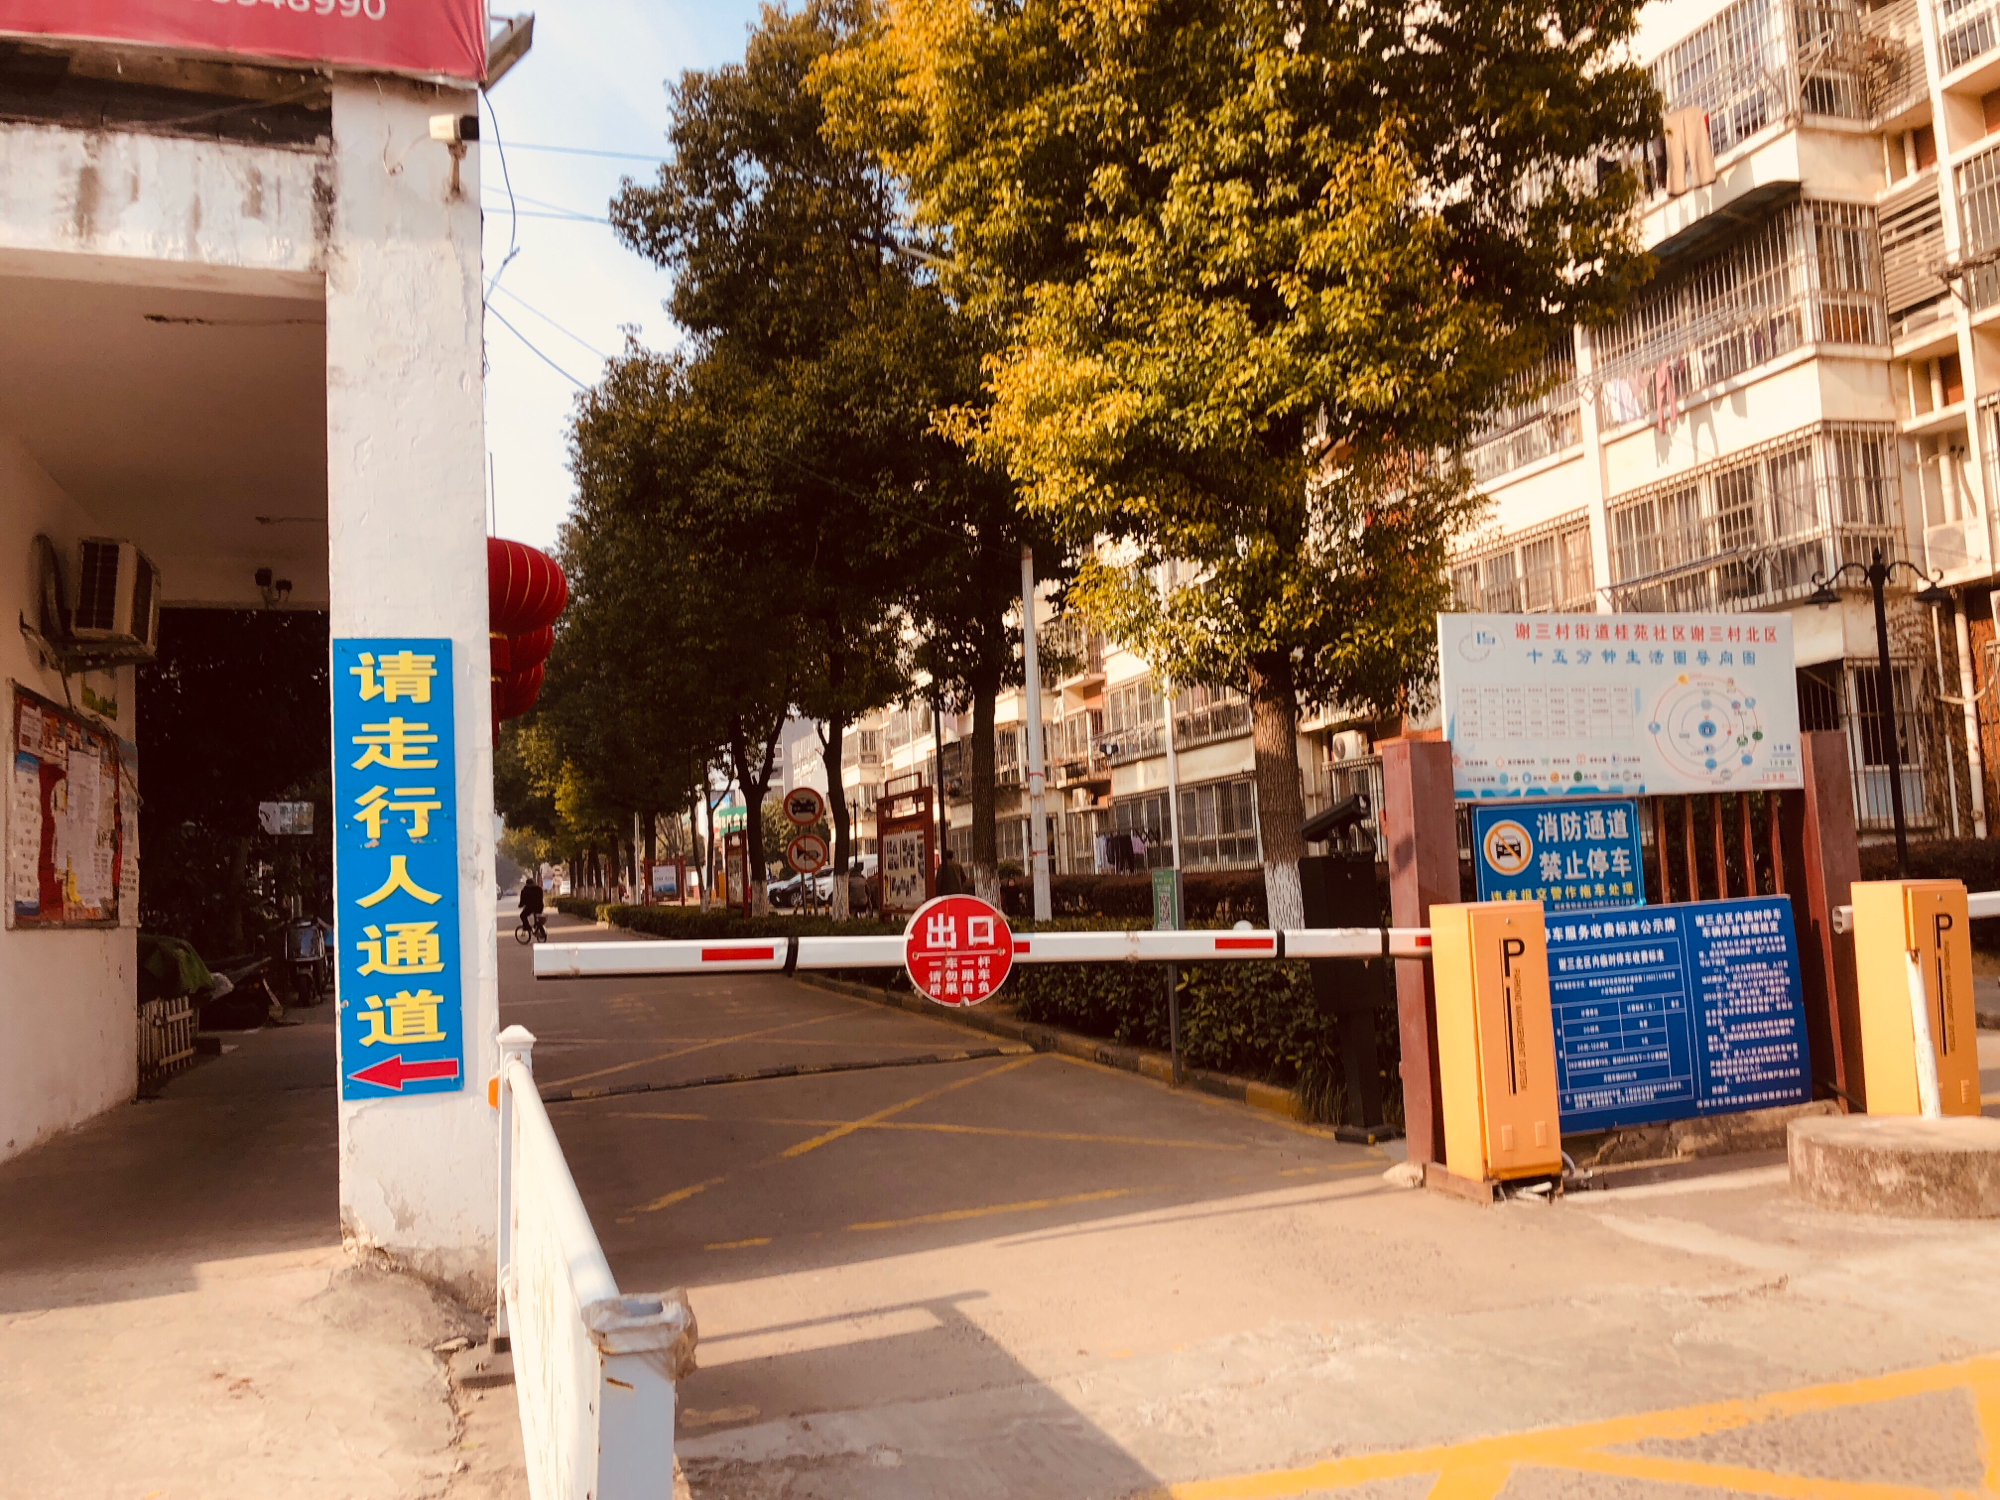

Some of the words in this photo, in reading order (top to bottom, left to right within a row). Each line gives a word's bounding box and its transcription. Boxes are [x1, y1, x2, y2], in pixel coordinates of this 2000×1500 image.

[1526, 648, 1756, 665] 十五分钟生活圈导向图
[1536, 808, 1629, 843] 消防通道
[349, 650, 446, 1047] 请走行人通道
[1539, 846, 1632, 882] 禁止停车
[926, 912, 995, 949] 出口
[1935, 913, 1953, 948] P
[928, 955, 991, 970] 一车一杆
[1503, 938, 1525, 977] P
[928, 968, 991, 983] 请勿跟车
[929, 981, 990, 996] 后果自负
